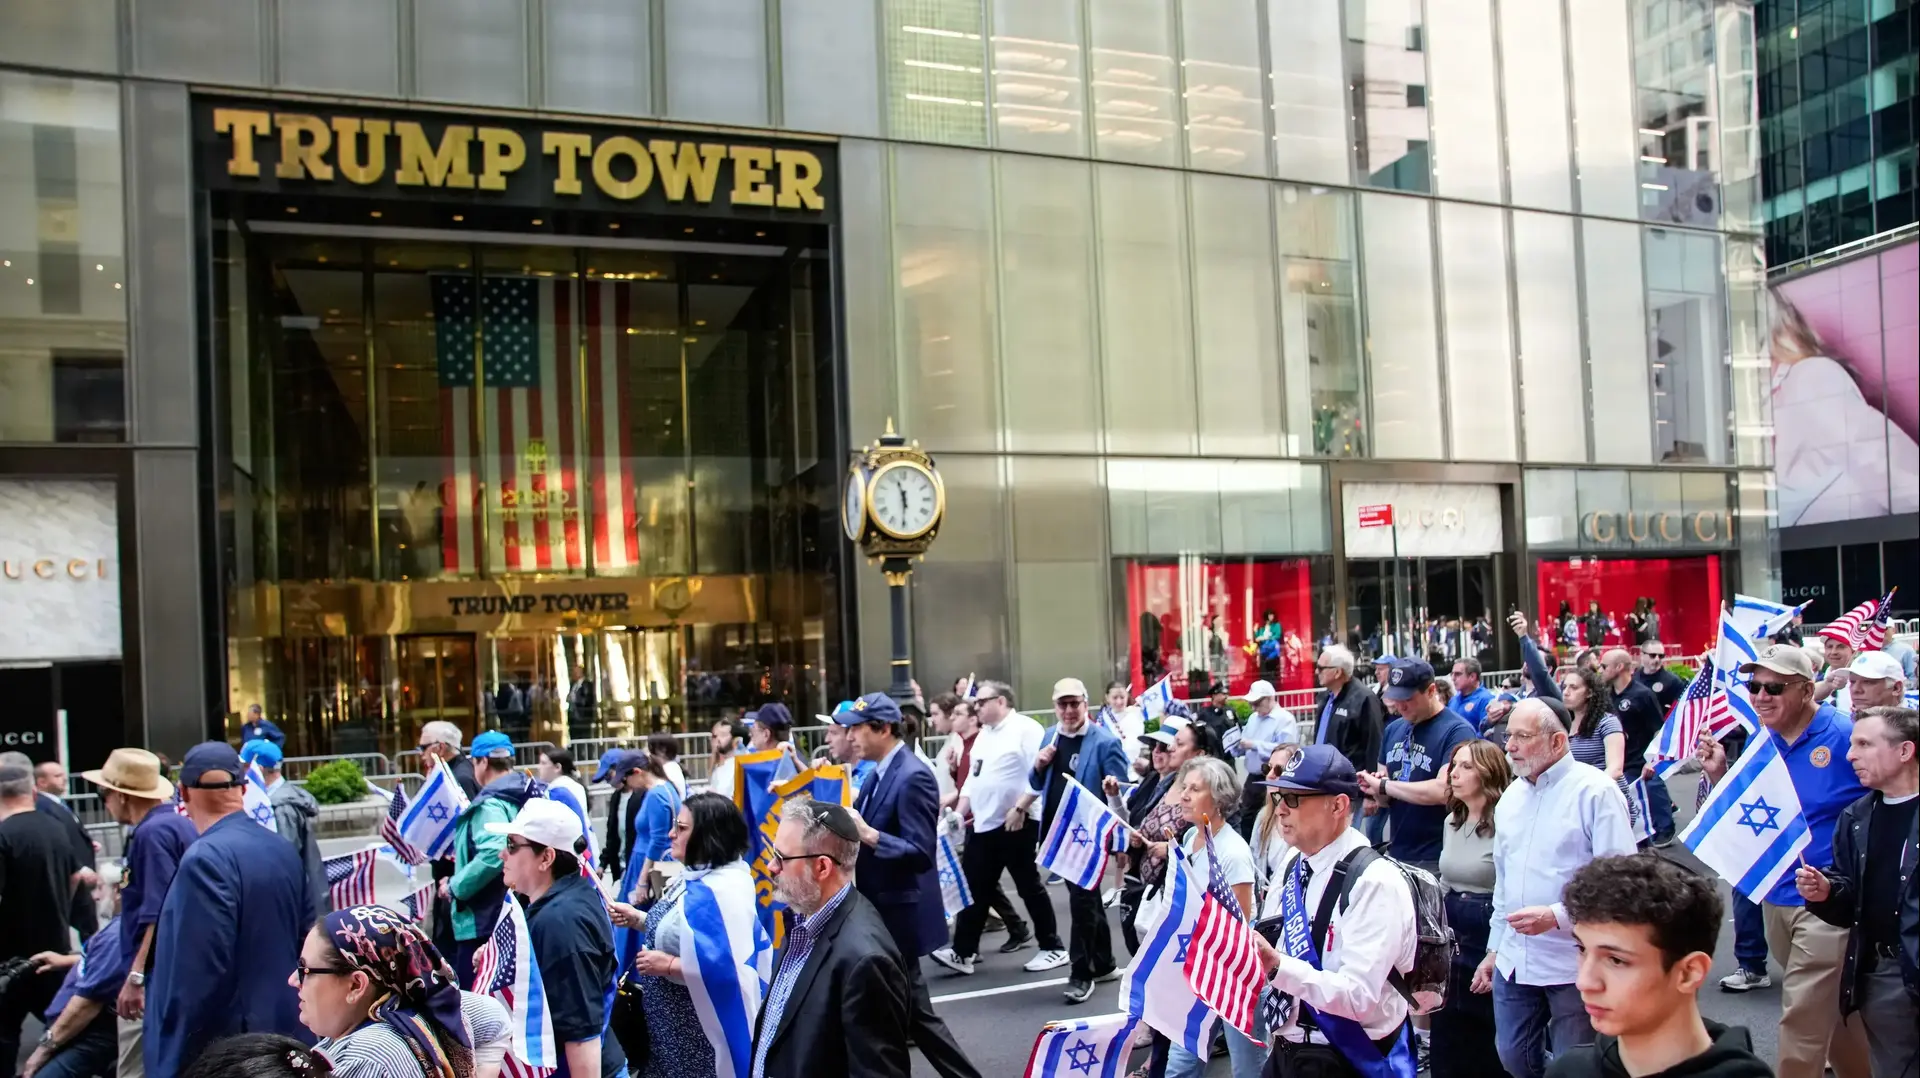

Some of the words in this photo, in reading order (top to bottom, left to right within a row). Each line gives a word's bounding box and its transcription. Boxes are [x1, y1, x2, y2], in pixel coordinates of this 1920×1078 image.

[213, 108, 526, 191] TRUMP
[542, 131, 824, 210] TOWER
[1398, 508, 1467, 530] UCCI
[1591, 510, 1733, 542] GUCCI
[448, 595, 537, 616] TRUMP
[542, 592, 630, 613] TOWER
[0, 731, 44, 746] CCI
[1286, 911, 1310, 959] ISRAEL
